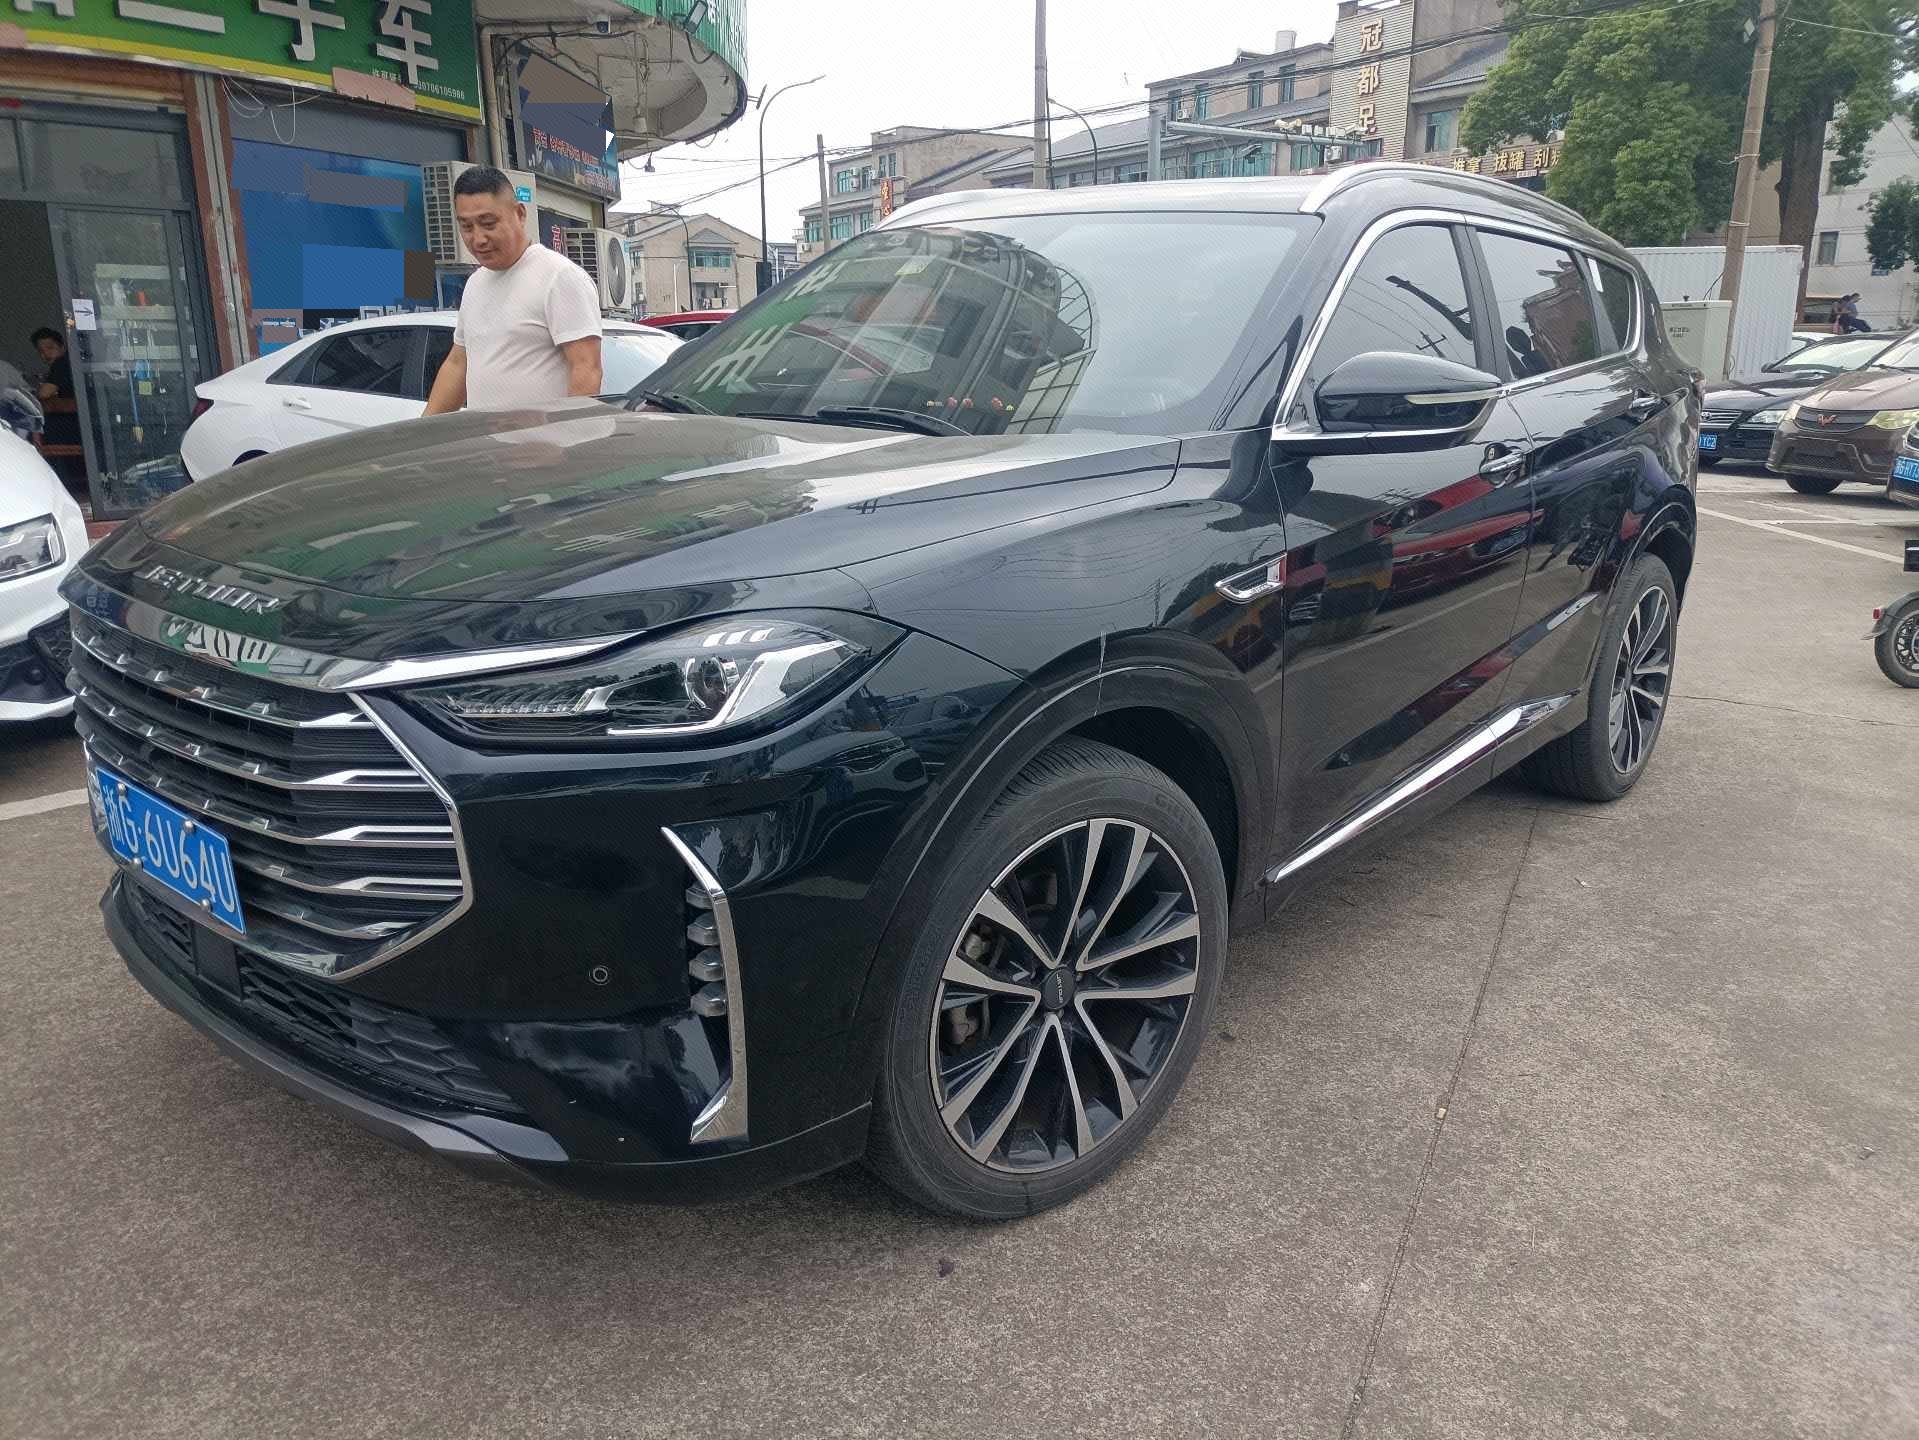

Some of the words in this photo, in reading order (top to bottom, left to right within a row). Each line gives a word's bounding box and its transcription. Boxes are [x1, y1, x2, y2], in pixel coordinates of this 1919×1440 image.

[14, 0, 439, 86] 二手车
[1494, 150, 1526, 172] 拔罐
[144, 564, 279, 615] JETOUR
